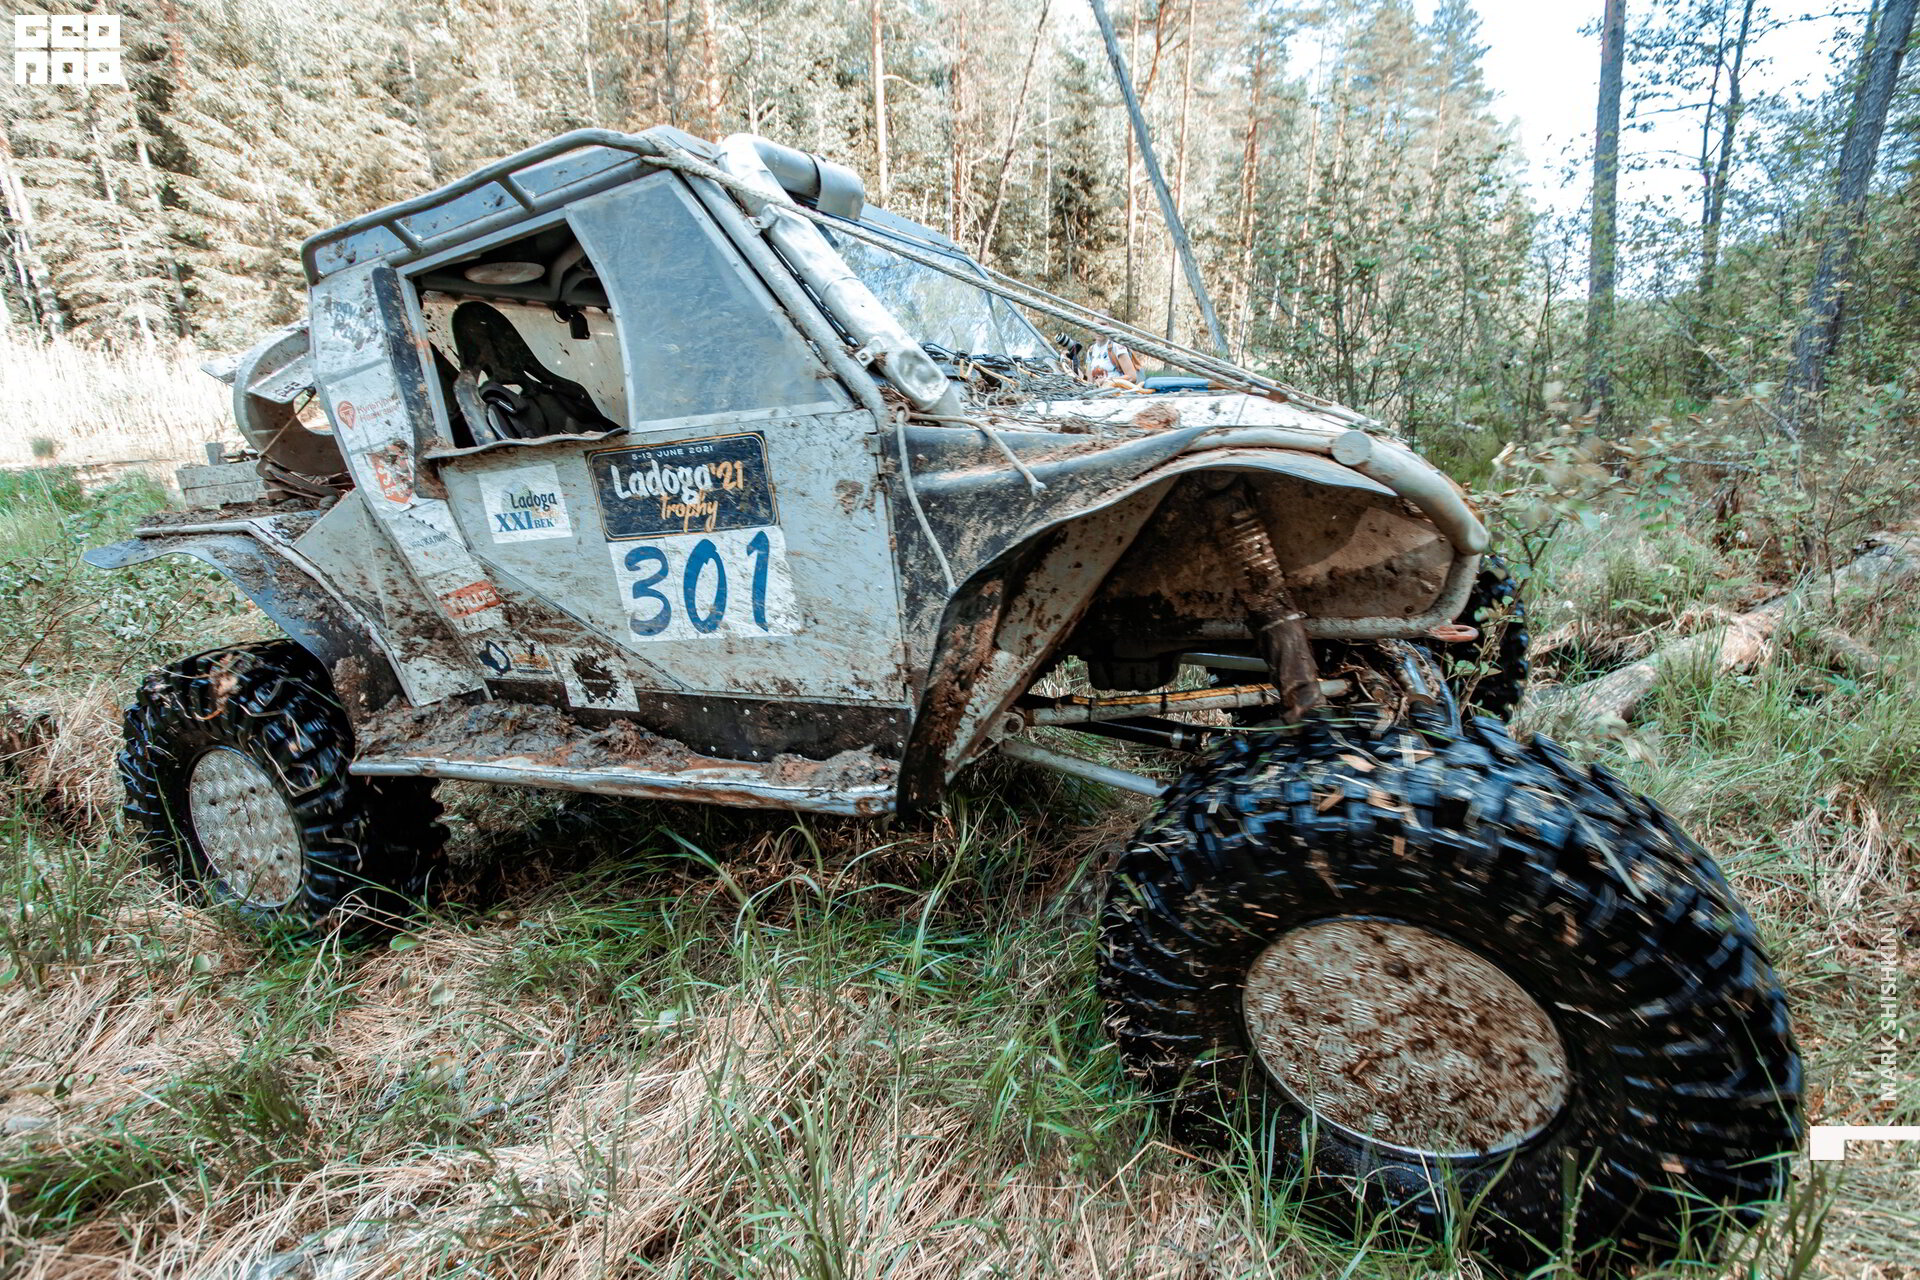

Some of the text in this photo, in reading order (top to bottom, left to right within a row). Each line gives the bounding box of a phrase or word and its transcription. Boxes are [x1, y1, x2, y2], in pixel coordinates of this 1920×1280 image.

[656, 448, 684, 458] JUNE
[689, 445, 714, 455] 2021
[510, 487, 558, 512] Ladoga
[659, 488, 719, 533] Trophy
[494, 510, 533, 533] XXI
[624, 531, 770, 637] 301
